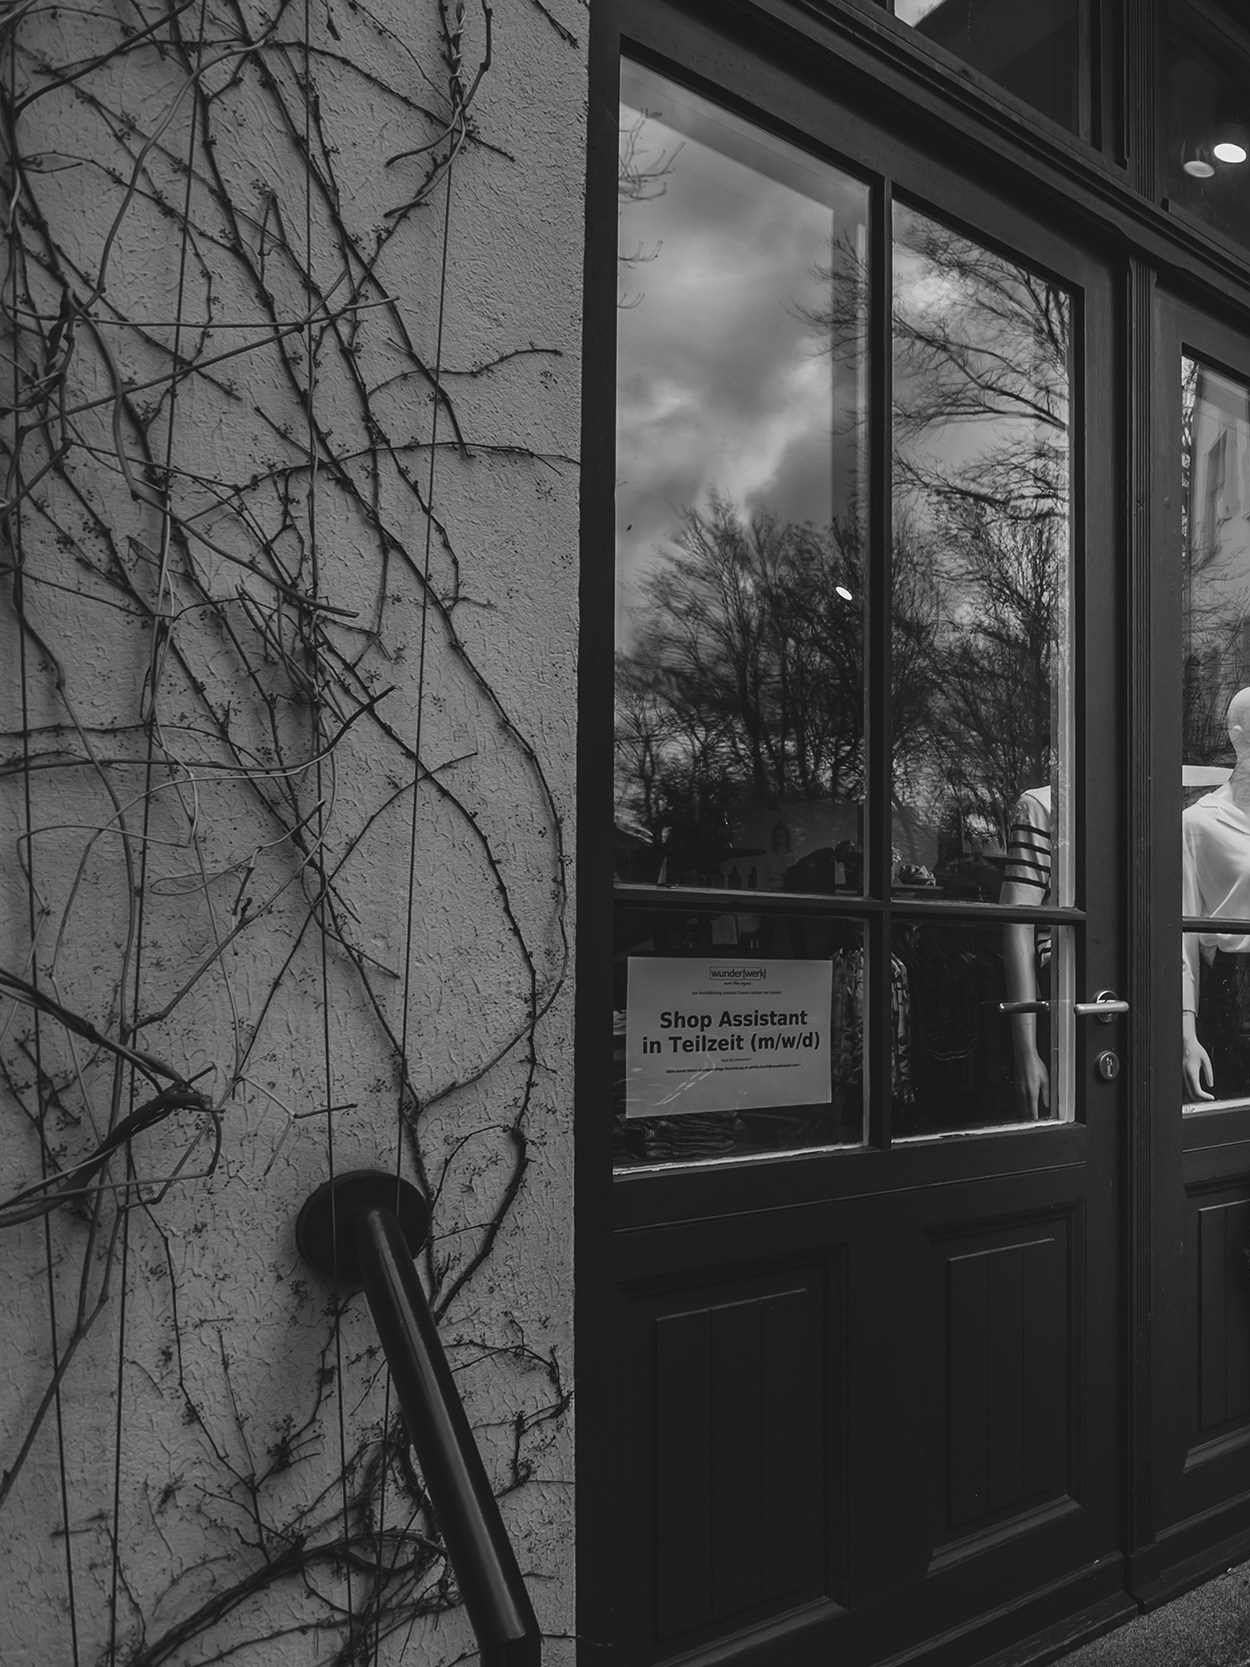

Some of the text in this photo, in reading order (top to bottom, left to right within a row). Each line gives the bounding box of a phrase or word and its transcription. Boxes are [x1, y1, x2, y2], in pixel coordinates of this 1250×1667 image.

[659, 1009, 808, 1031] Shop Assistant
[642, 1031, 820, 1054] in Teilzeit (m/w/d)
